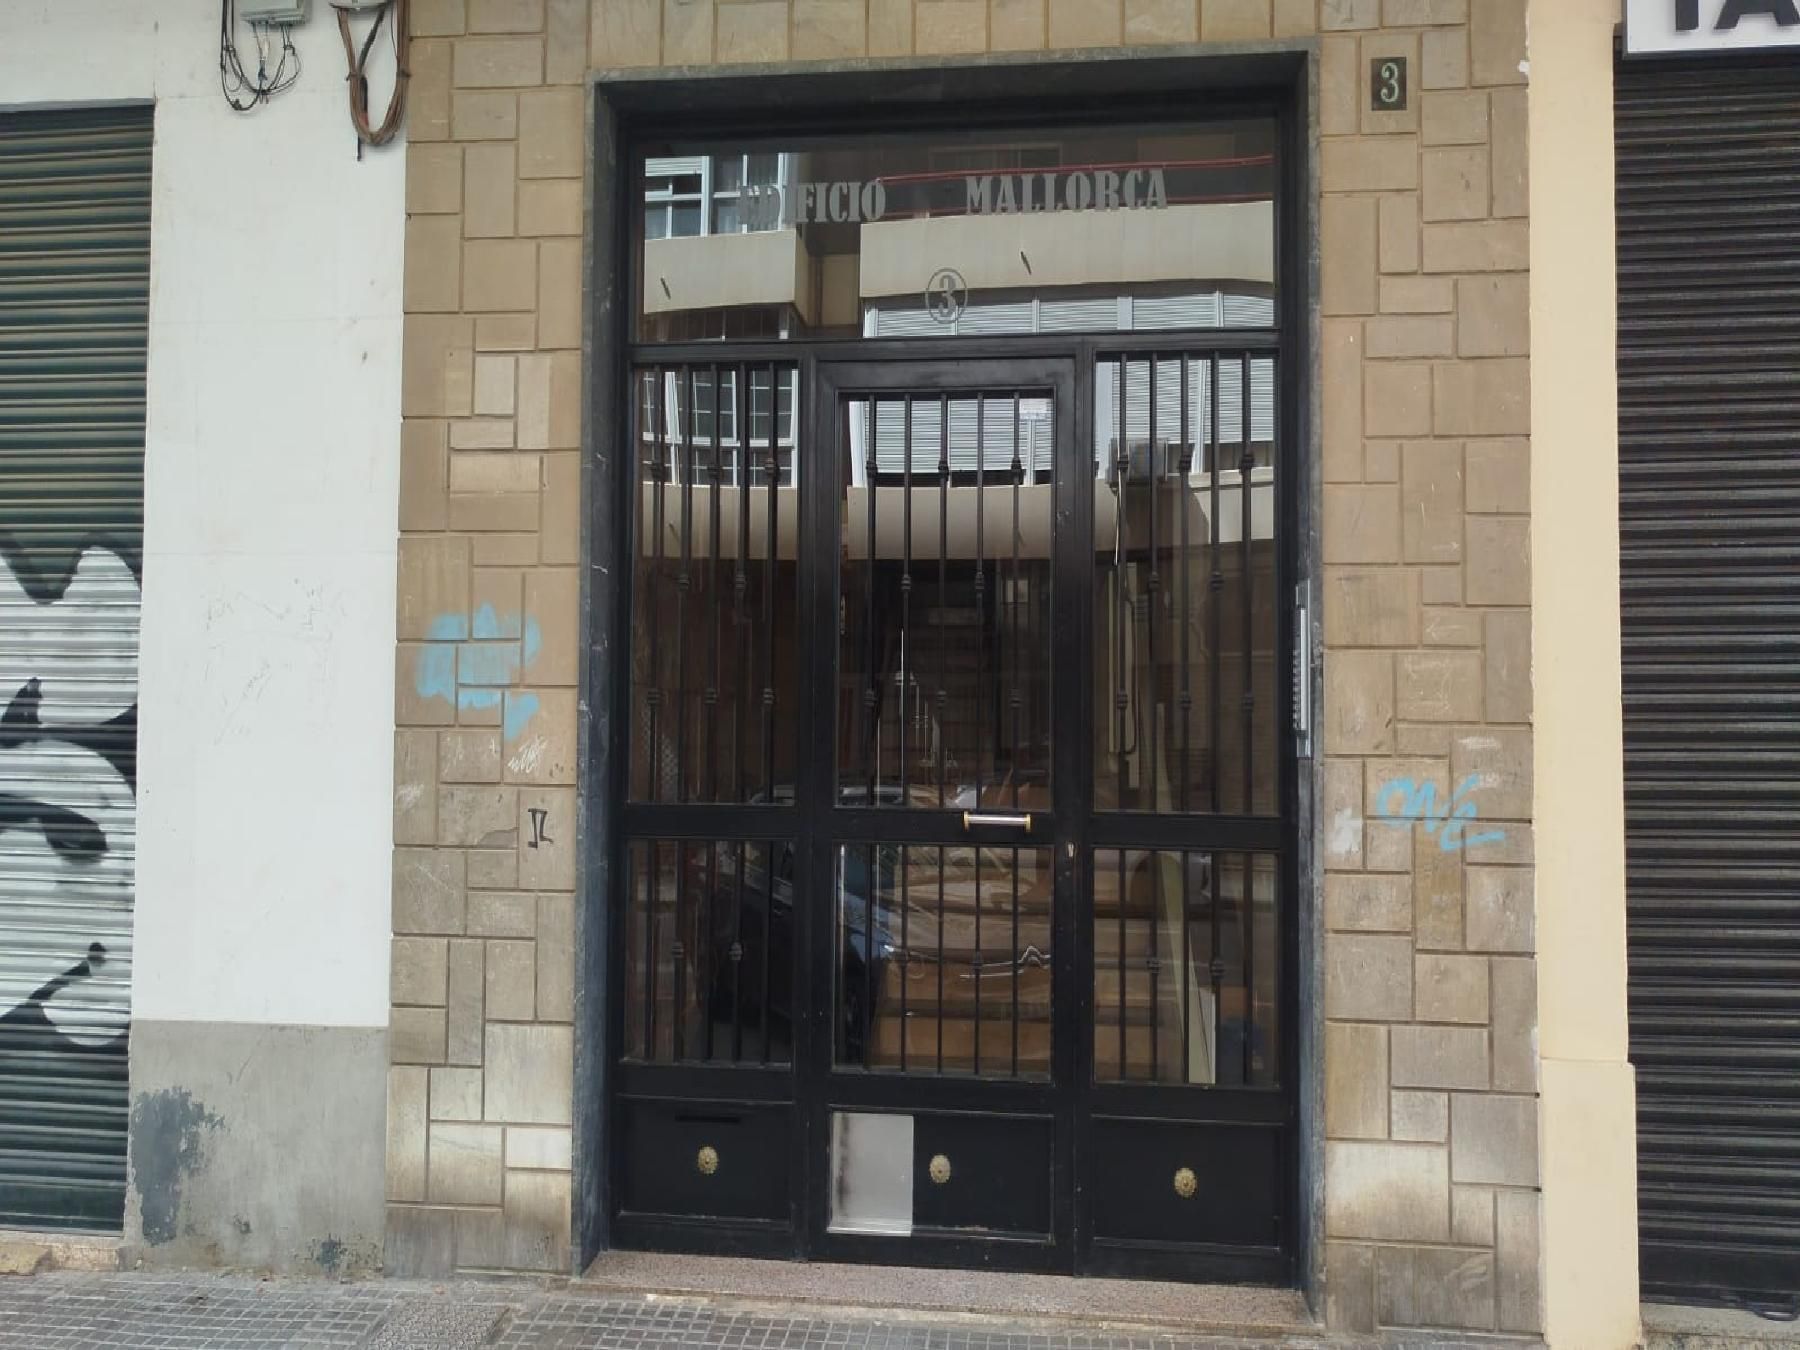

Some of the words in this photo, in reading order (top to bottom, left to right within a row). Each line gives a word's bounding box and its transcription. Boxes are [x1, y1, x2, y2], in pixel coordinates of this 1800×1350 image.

[1380, 62, 1399, 103] 3
[965, 168, 1169, 216] MALLORCA
[938, 274, 957, 318] 3
